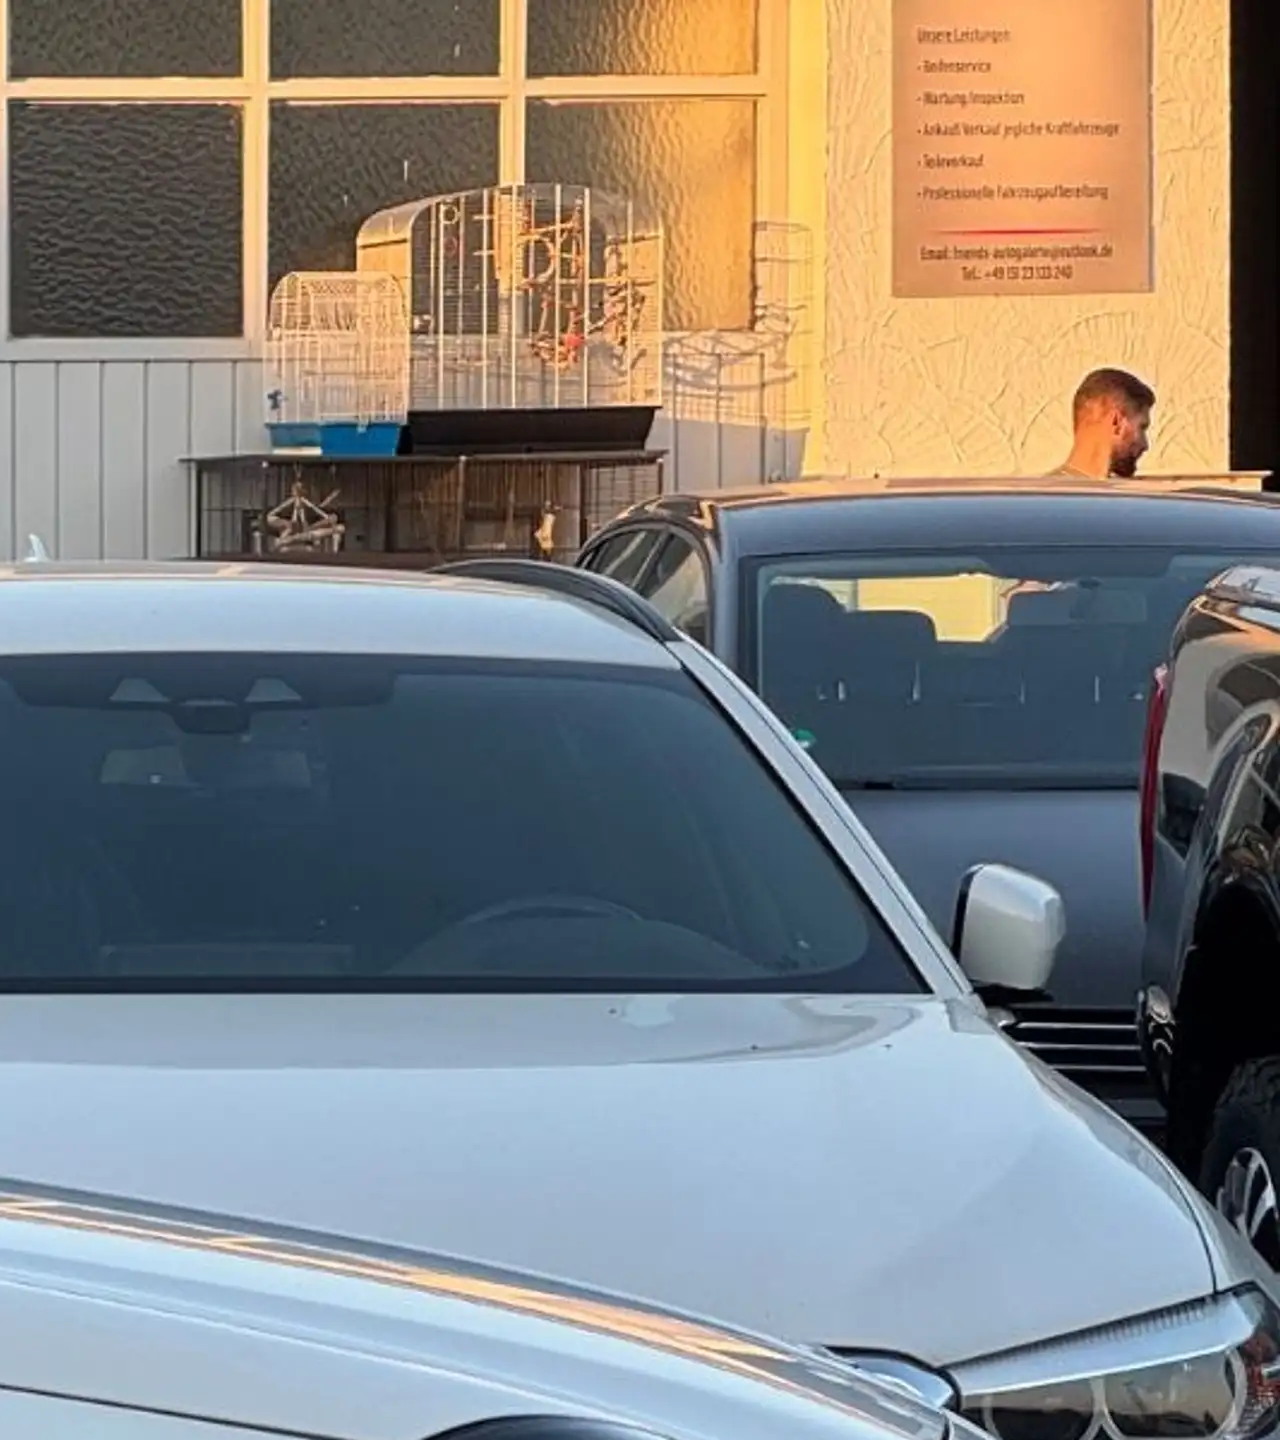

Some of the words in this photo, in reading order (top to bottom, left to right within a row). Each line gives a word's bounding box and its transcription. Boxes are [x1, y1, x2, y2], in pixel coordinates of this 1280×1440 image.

[917, 28, 952, 44] Unsere
[954, 28, 1011, 45] Leistungen
[923, 60, 991, 73] Reifenservice
[1003, 122, 1042, 139] jegliche
[1045, 122, 1120, 137] Kraftfahrzeuge
[923, 153, 984, 169] Teileverkauf
[922, 185, 995, 201] Professionelle
[997, 184, 1109, 202] Fahrzeugaufbereitung
[920, 244, 951, 261] Email:
